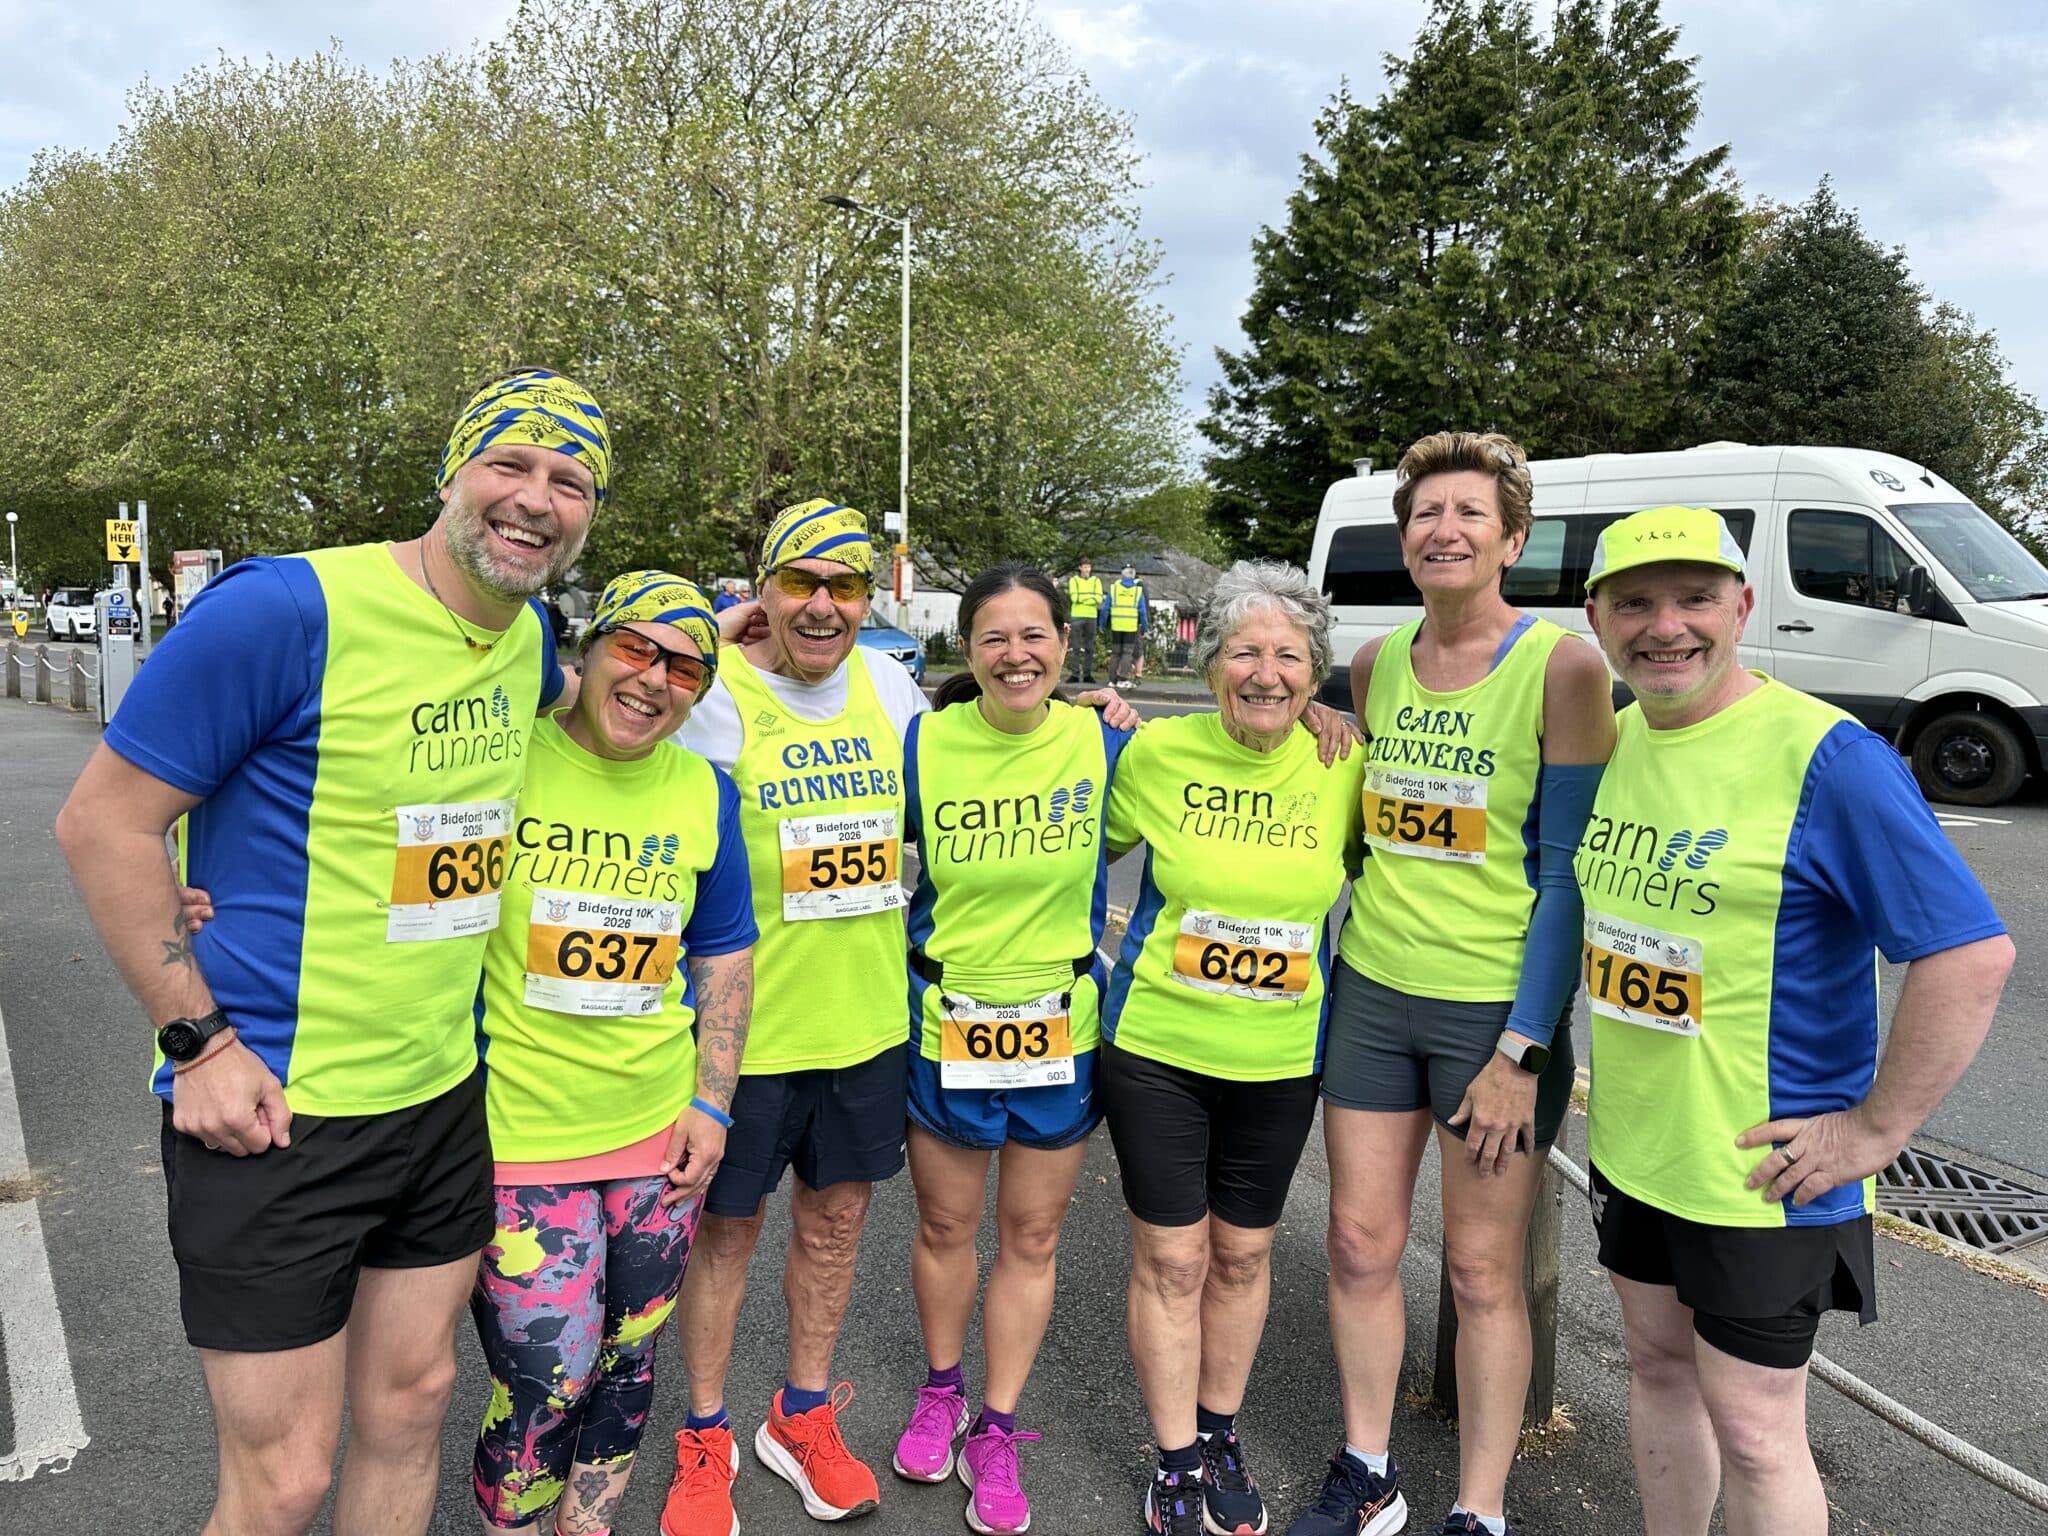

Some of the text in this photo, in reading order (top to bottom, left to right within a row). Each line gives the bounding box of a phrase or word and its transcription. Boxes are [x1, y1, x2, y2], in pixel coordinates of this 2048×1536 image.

[114, 522, 133, 531] PAY
[411, 696, 488, 735] carn
[1396, 705, 1476, 738] CARN
[409, 728, 522, 773] runners
[782, 736, 873, 769] CARN
[758, 769, 898, 810] RUNNERS
[1385, 774, 1448, 792] Bideford 10K
[1401, 788, 1425, 799] 2026
[934, 793, 1042, 832] carn
[1184, 782, 1273, 818] carn
[441, 809, 501, 826] Bideford 10K
[462, 824, 483, 837] 2026
[816, 818, 879, 833] Bideford 10K
[1179, 810, 1318, 849] runners
[1376, 798, 1458, 847] 554
[516, 817, 631, 861] carn
[839, 830, 862, 842] 2026
[935, 816, 1095, 865] runners
[428, 840, 504, 899] 636
[507, 851, 679, 901] runners
[809, 842, 887, 889] 555
[1576, 852, 1720, 915] unners
[578, 902, 654, 919] Bideford 10K
[884, 895, 898, 906] 555
[603, 917, 631, 929] 2026
[1217, 920, 1283, 937] Bideford 10K
[1597, 922, 1660, 950] Bideford 10K
[557, 930, 658, 980] 637
[1612, 939, 1637, 955] 2026
[1199, 942, 1288, 989] 602
[1587, 947, 1689, 1016] 1165
[641, 999, 656, 1011] 637
[996, 1010, 1021, 1019] 2026
[1023, 1000, 1041, 1009] 10K
[966, 1021, 1049, 1059] 603
[1047, 1071, 1067, 1081] 603
